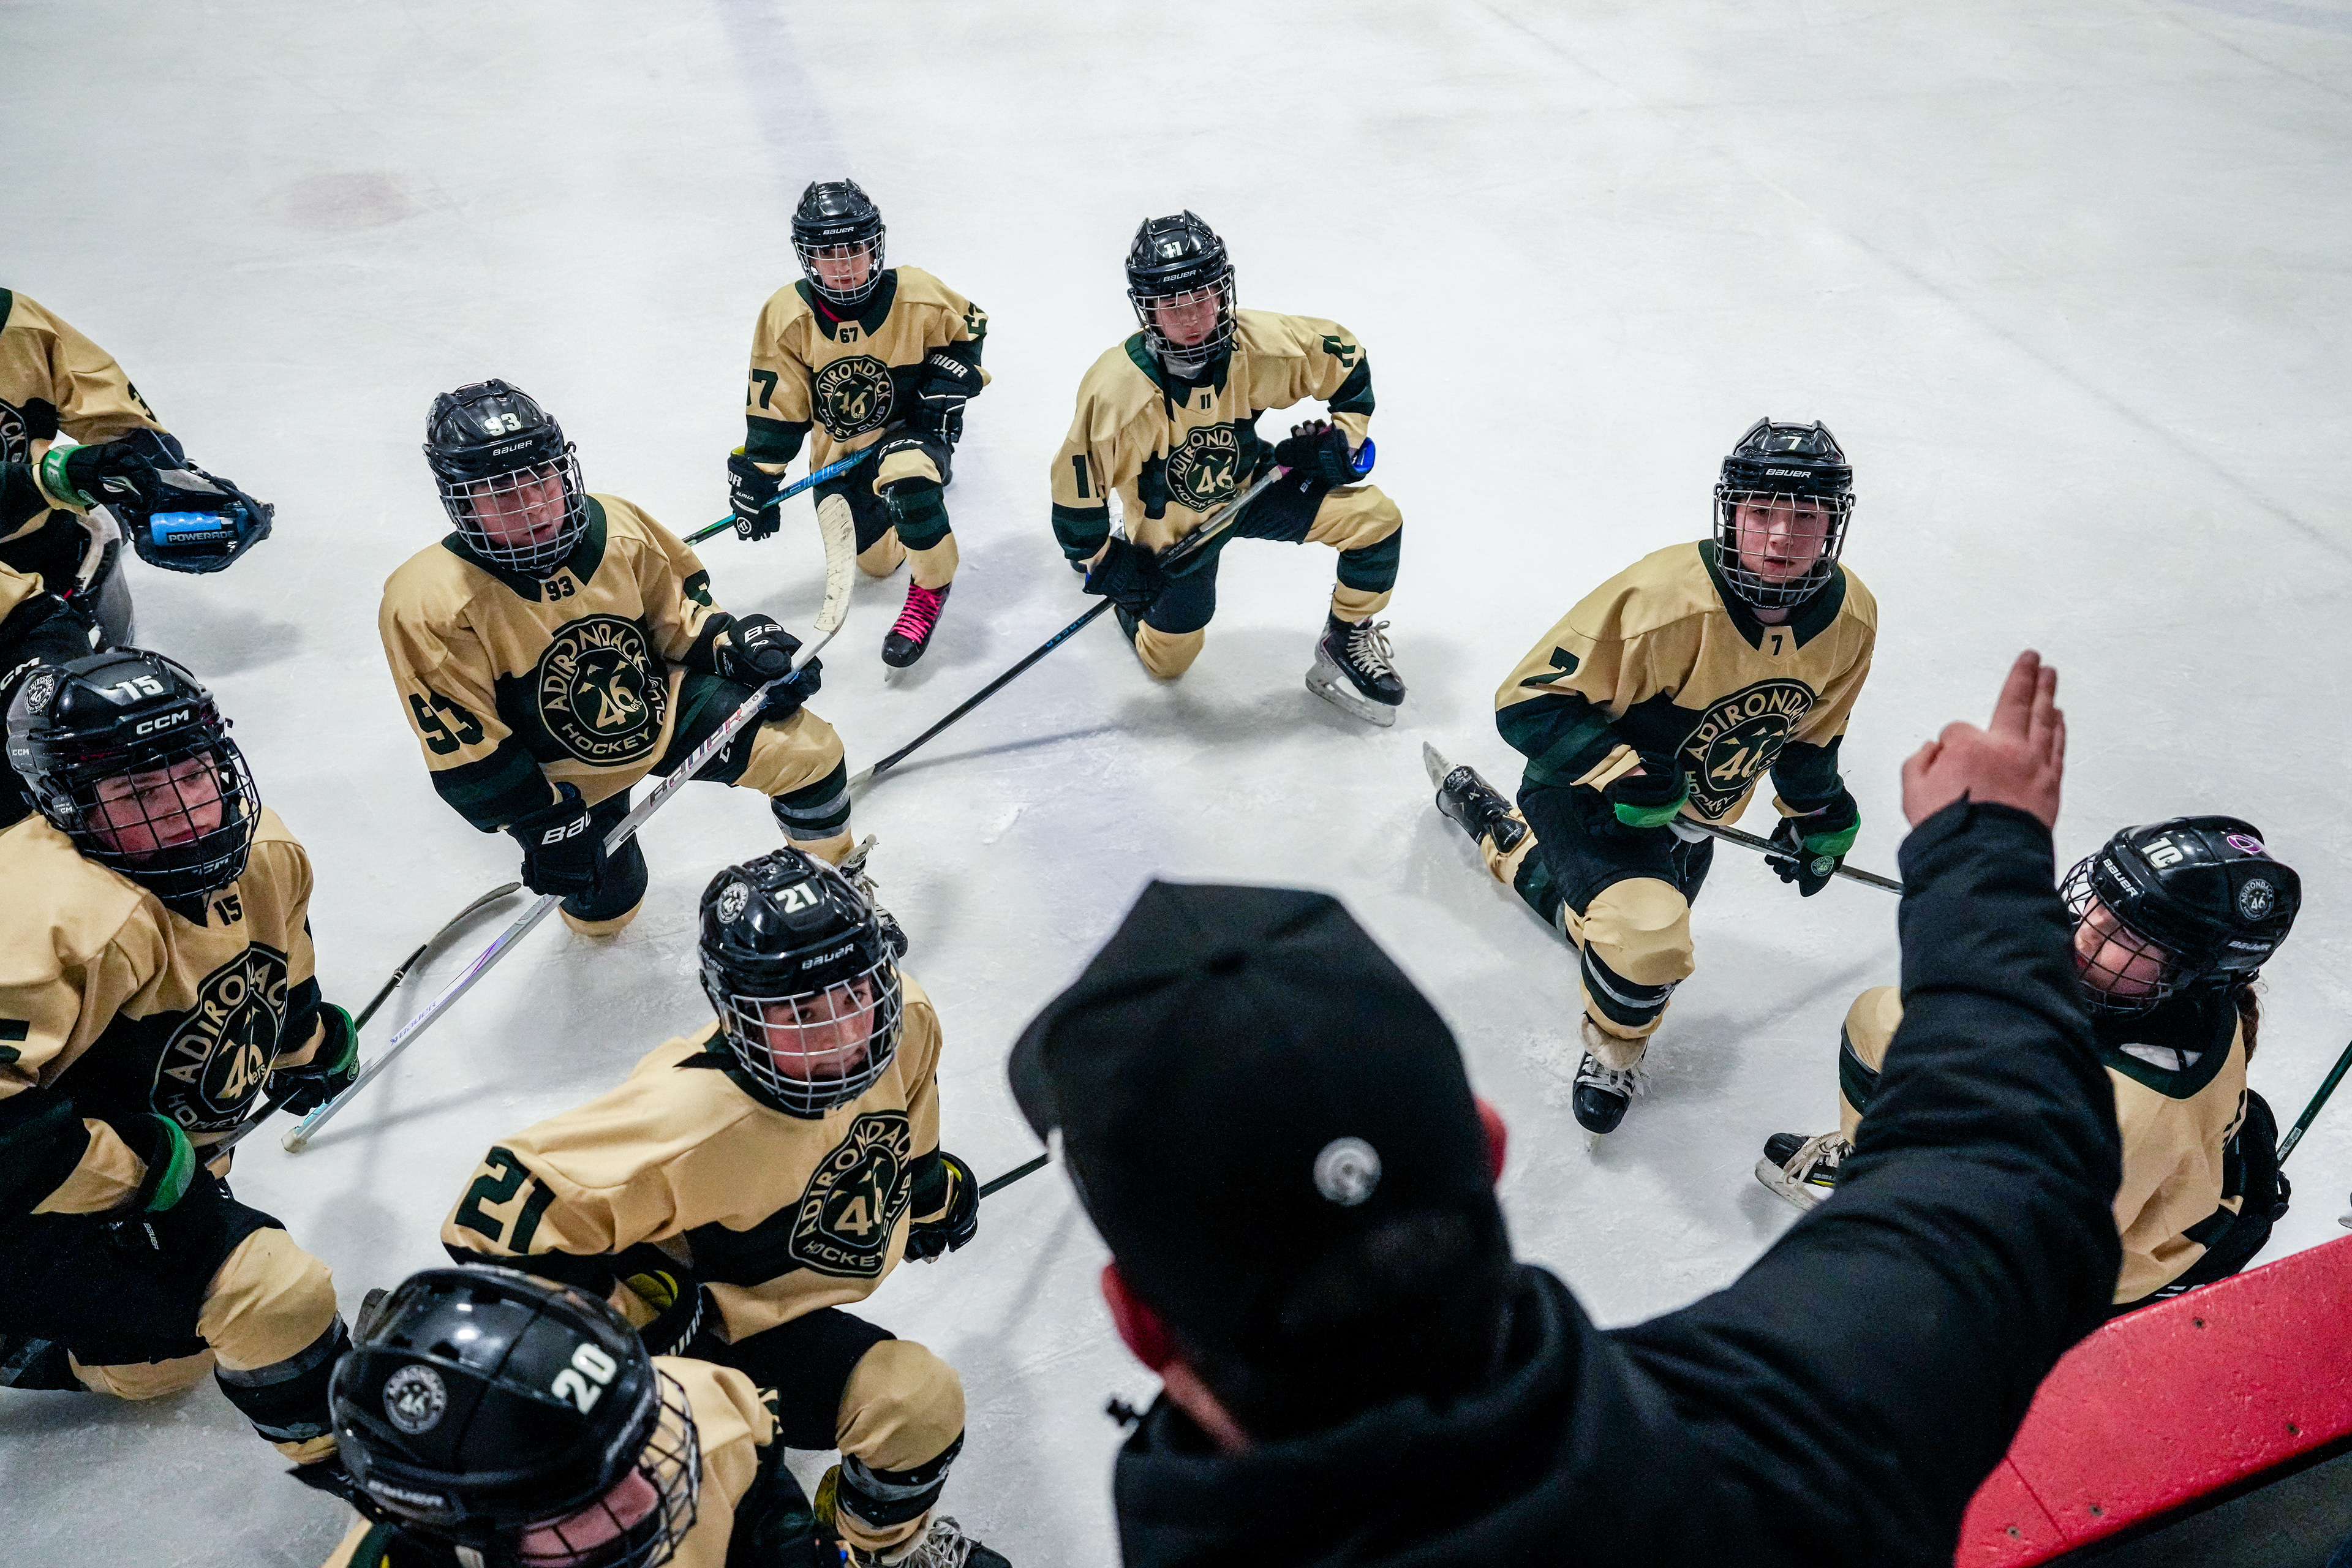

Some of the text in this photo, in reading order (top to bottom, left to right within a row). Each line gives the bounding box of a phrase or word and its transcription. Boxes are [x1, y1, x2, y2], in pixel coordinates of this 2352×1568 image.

[823, 227, 854, 235] BAUER
[1164, 241, 1183, 258] 11
[1163, 270, 1196, 282] BAUER
[839, 327, 858, 344] 67
[746, 369, 778, 410] 7
[820, 360, 891, 403] ADIRONDACK
[1200, 394, 1212, 409] 11
[484, 413, 522, 436] 93
[822, 405, 886, 436] HOEY CLUB
[492, 440, 532, 456] BAUER
[1787, 436, 1802, 450] 7
[1765, 469, 1812, 478] BAUER
[736, 491, 754, 500] ALPHA
[168, 530, 235, 542] POWERADE
[545, 576, 575, 601] 93
[1771, 635, 1783, 656] 7
[544, 624, 646, 712] ADIRONDACK
[116, 675, 164, 700] 15
[136, 709, 189, 734] CCM
[409, 690, 485, 755] 93
[562, 723, 649, 754] HOCKEY
[650, 707, 744, 807] BAUER
[2141, 837, 2184, 869] 10
[2103, 858, 2138, 897] BAUER
[775, 883, 818, 914] 21
[2241, 881, 2273, 903] ADIRONDACK
[2251, 895, 2266, 910] 46
[213, 894, 243, 926] 15
[801, 943, 854, 970] BAUER
[454, 1145, 557, 1254] 21
[143, 1223, 159, 1250] BAUER
[551, 1342, 617, 1415] 20
